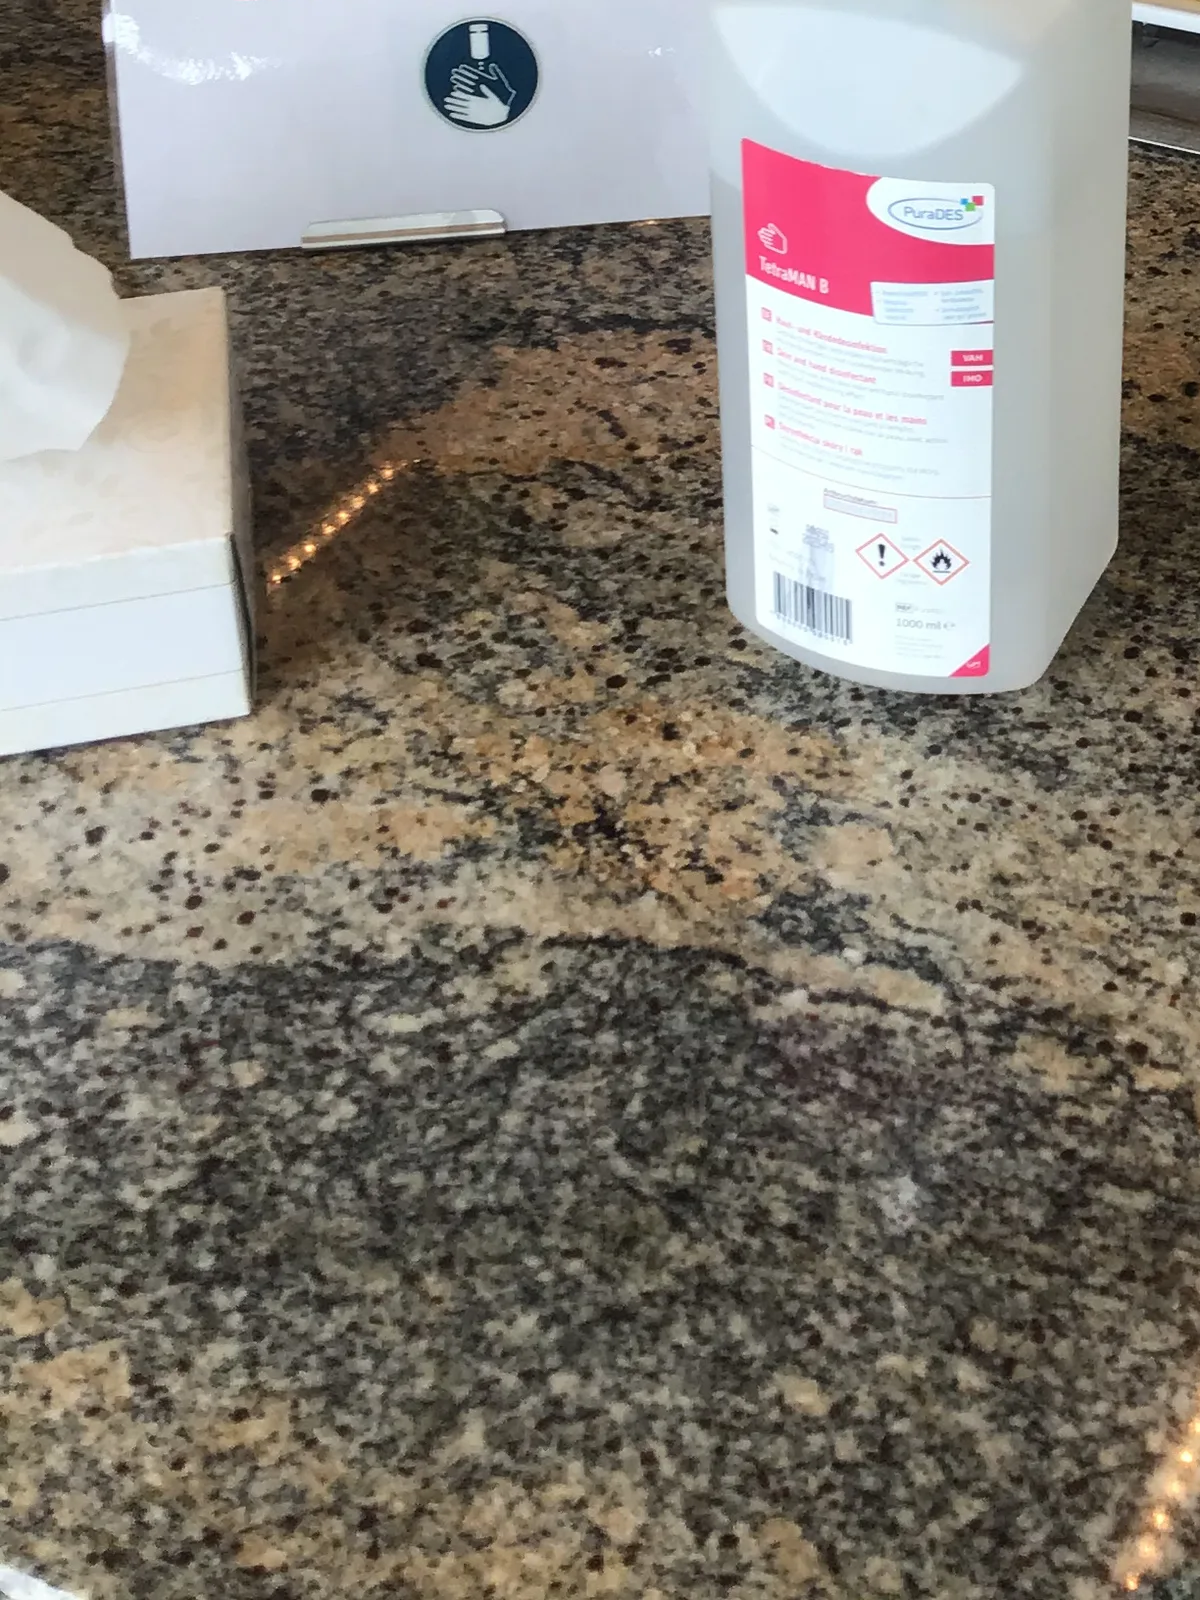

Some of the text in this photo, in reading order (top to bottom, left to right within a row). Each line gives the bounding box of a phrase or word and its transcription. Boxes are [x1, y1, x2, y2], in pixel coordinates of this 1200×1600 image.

[903, 206, 964, 221] PuraDES
[758, 255, 829, 294] TetraMAN B
[896, 618, 924, 629] 1000
